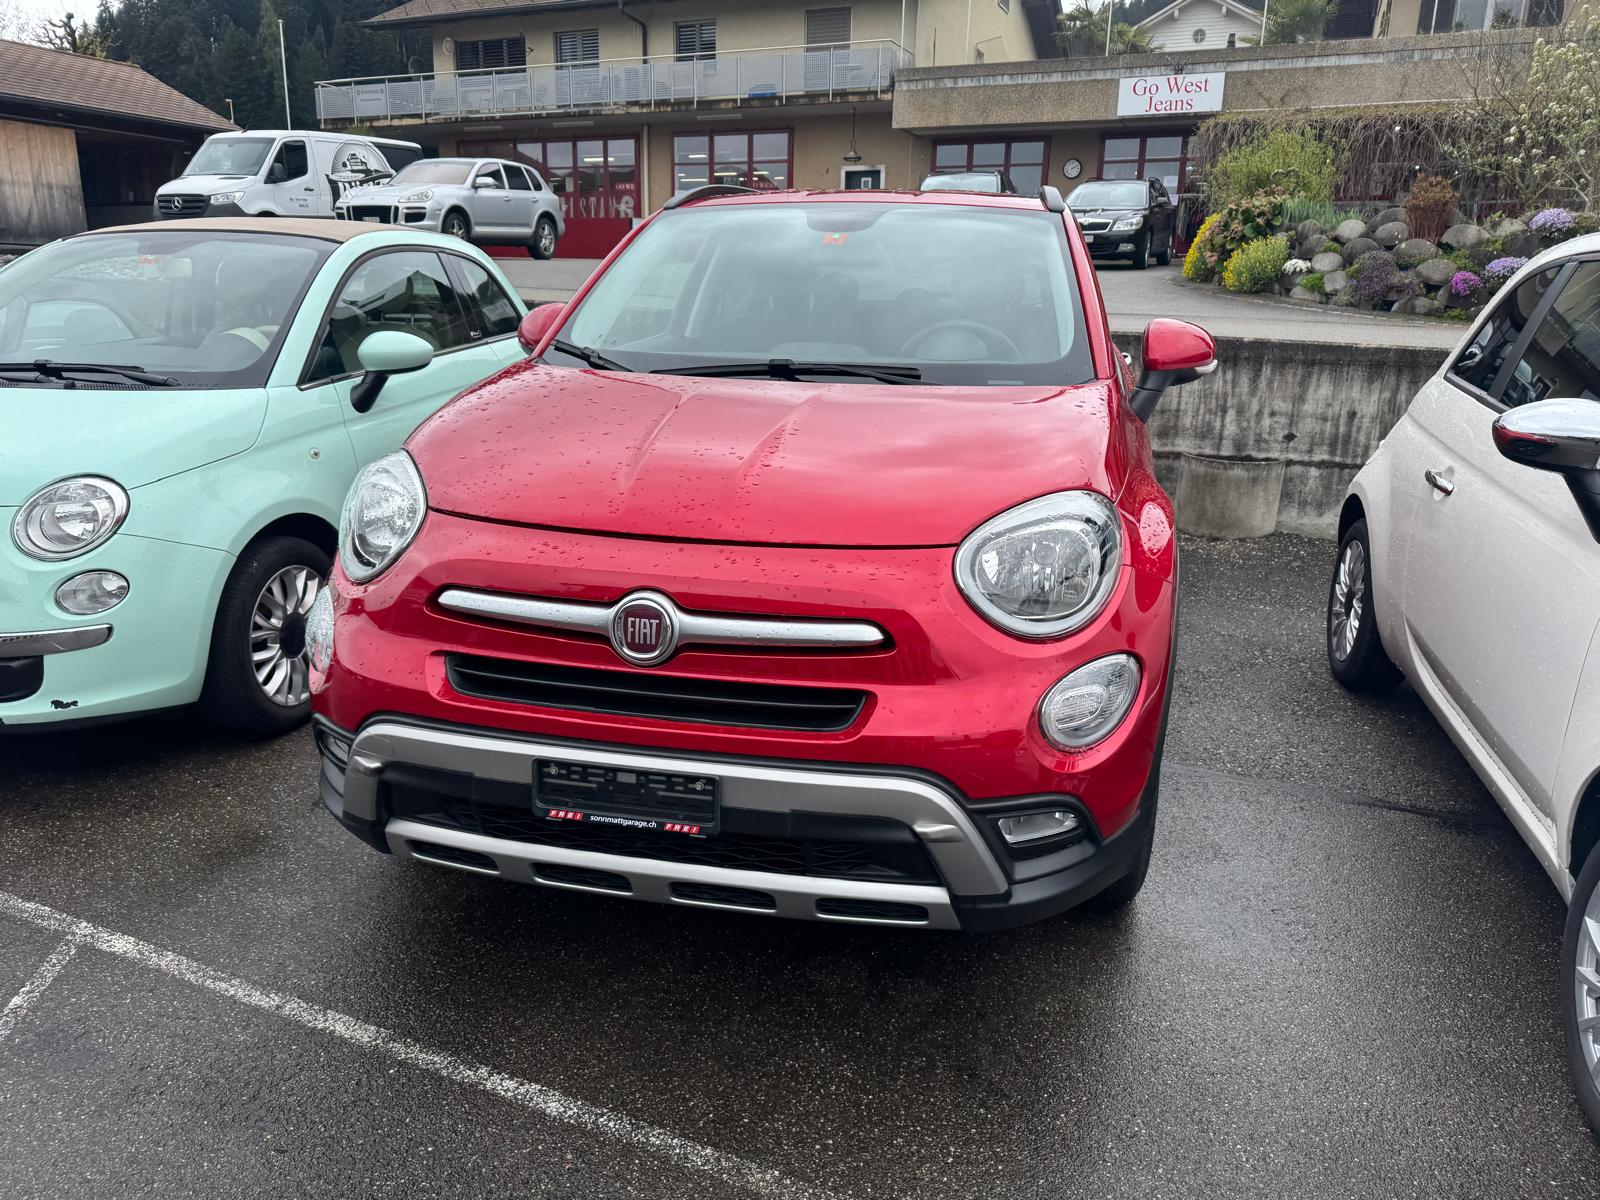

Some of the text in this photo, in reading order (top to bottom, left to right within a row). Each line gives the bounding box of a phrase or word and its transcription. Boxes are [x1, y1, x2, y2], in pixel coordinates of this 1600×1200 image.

[1132, 76, 1209, 96] Go West
[1145, 96, 1194, 112] Jeans
[627, 617, 660, 645] FIAT
[549, 809, 700, 834] FREI sonnmattgarage.ch FREI
